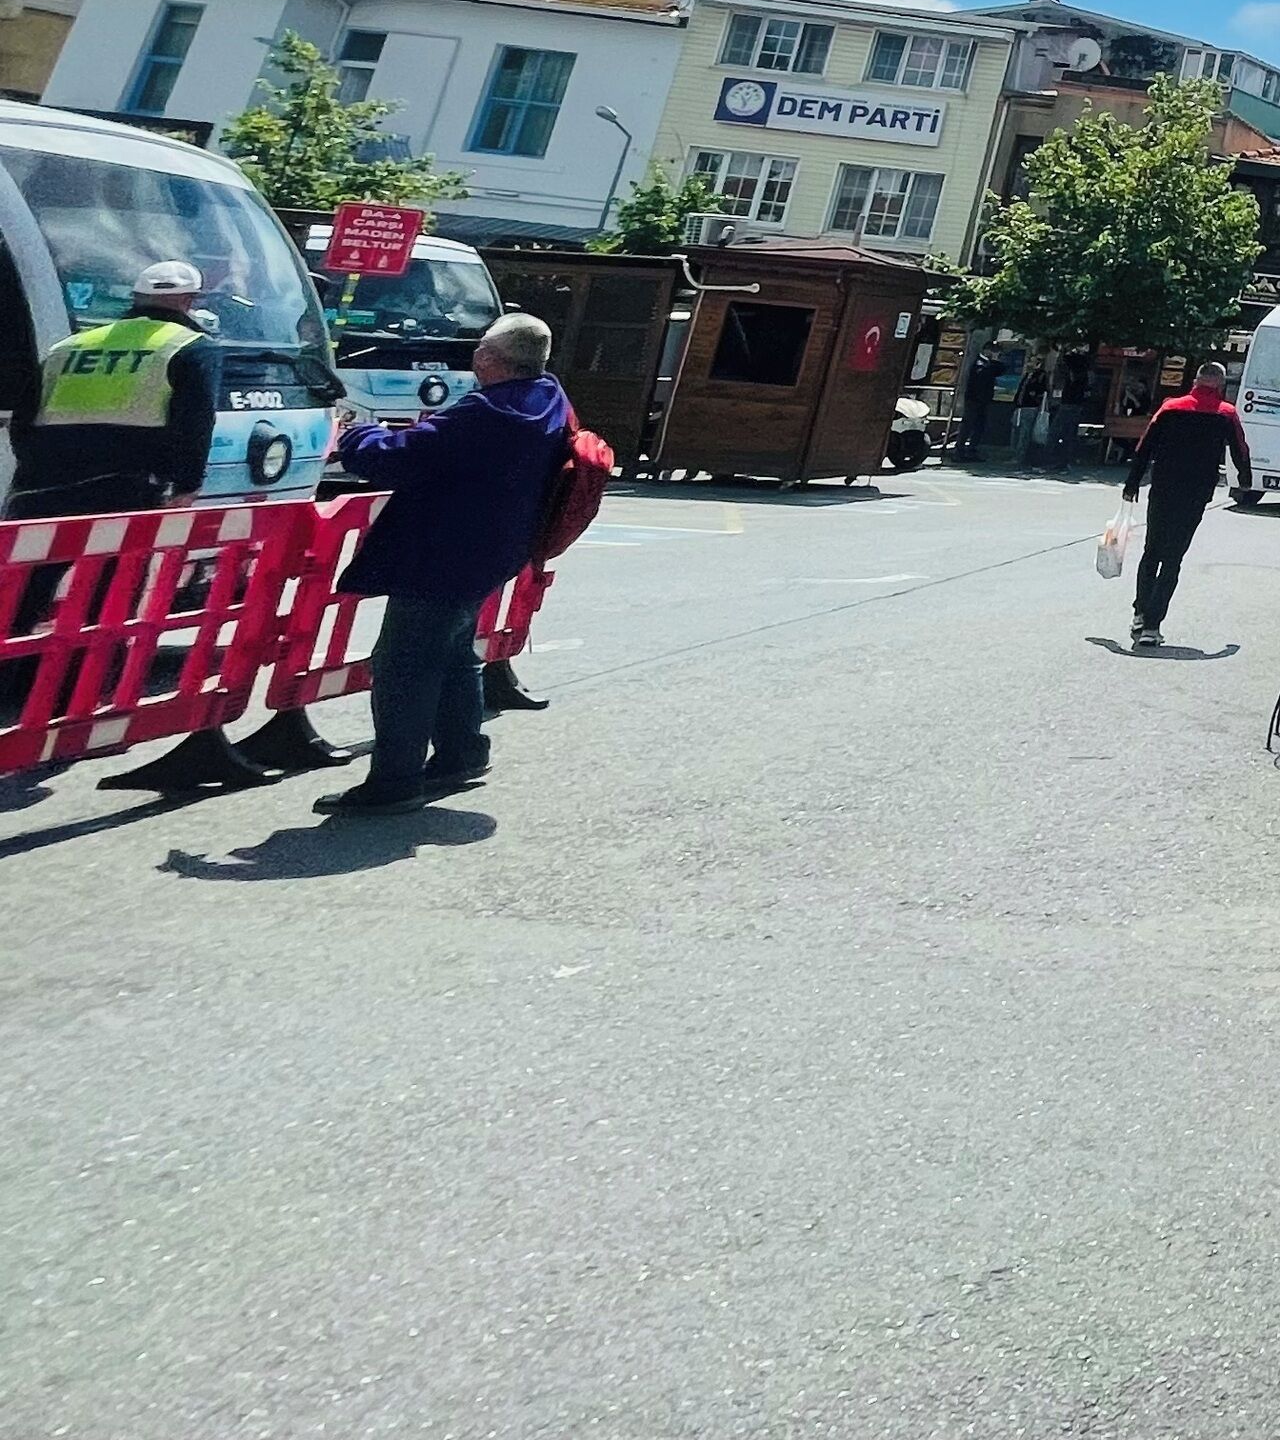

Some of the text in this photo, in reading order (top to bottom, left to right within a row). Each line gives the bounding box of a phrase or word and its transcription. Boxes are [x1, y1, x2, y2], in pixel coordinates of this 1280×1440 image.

[777, 96, 842, 122] DEM
[344, 228, 405, 240] MADEN
[341, 239, 403, 250] BELTUR
[230, 391, 284, 410] E-1002
